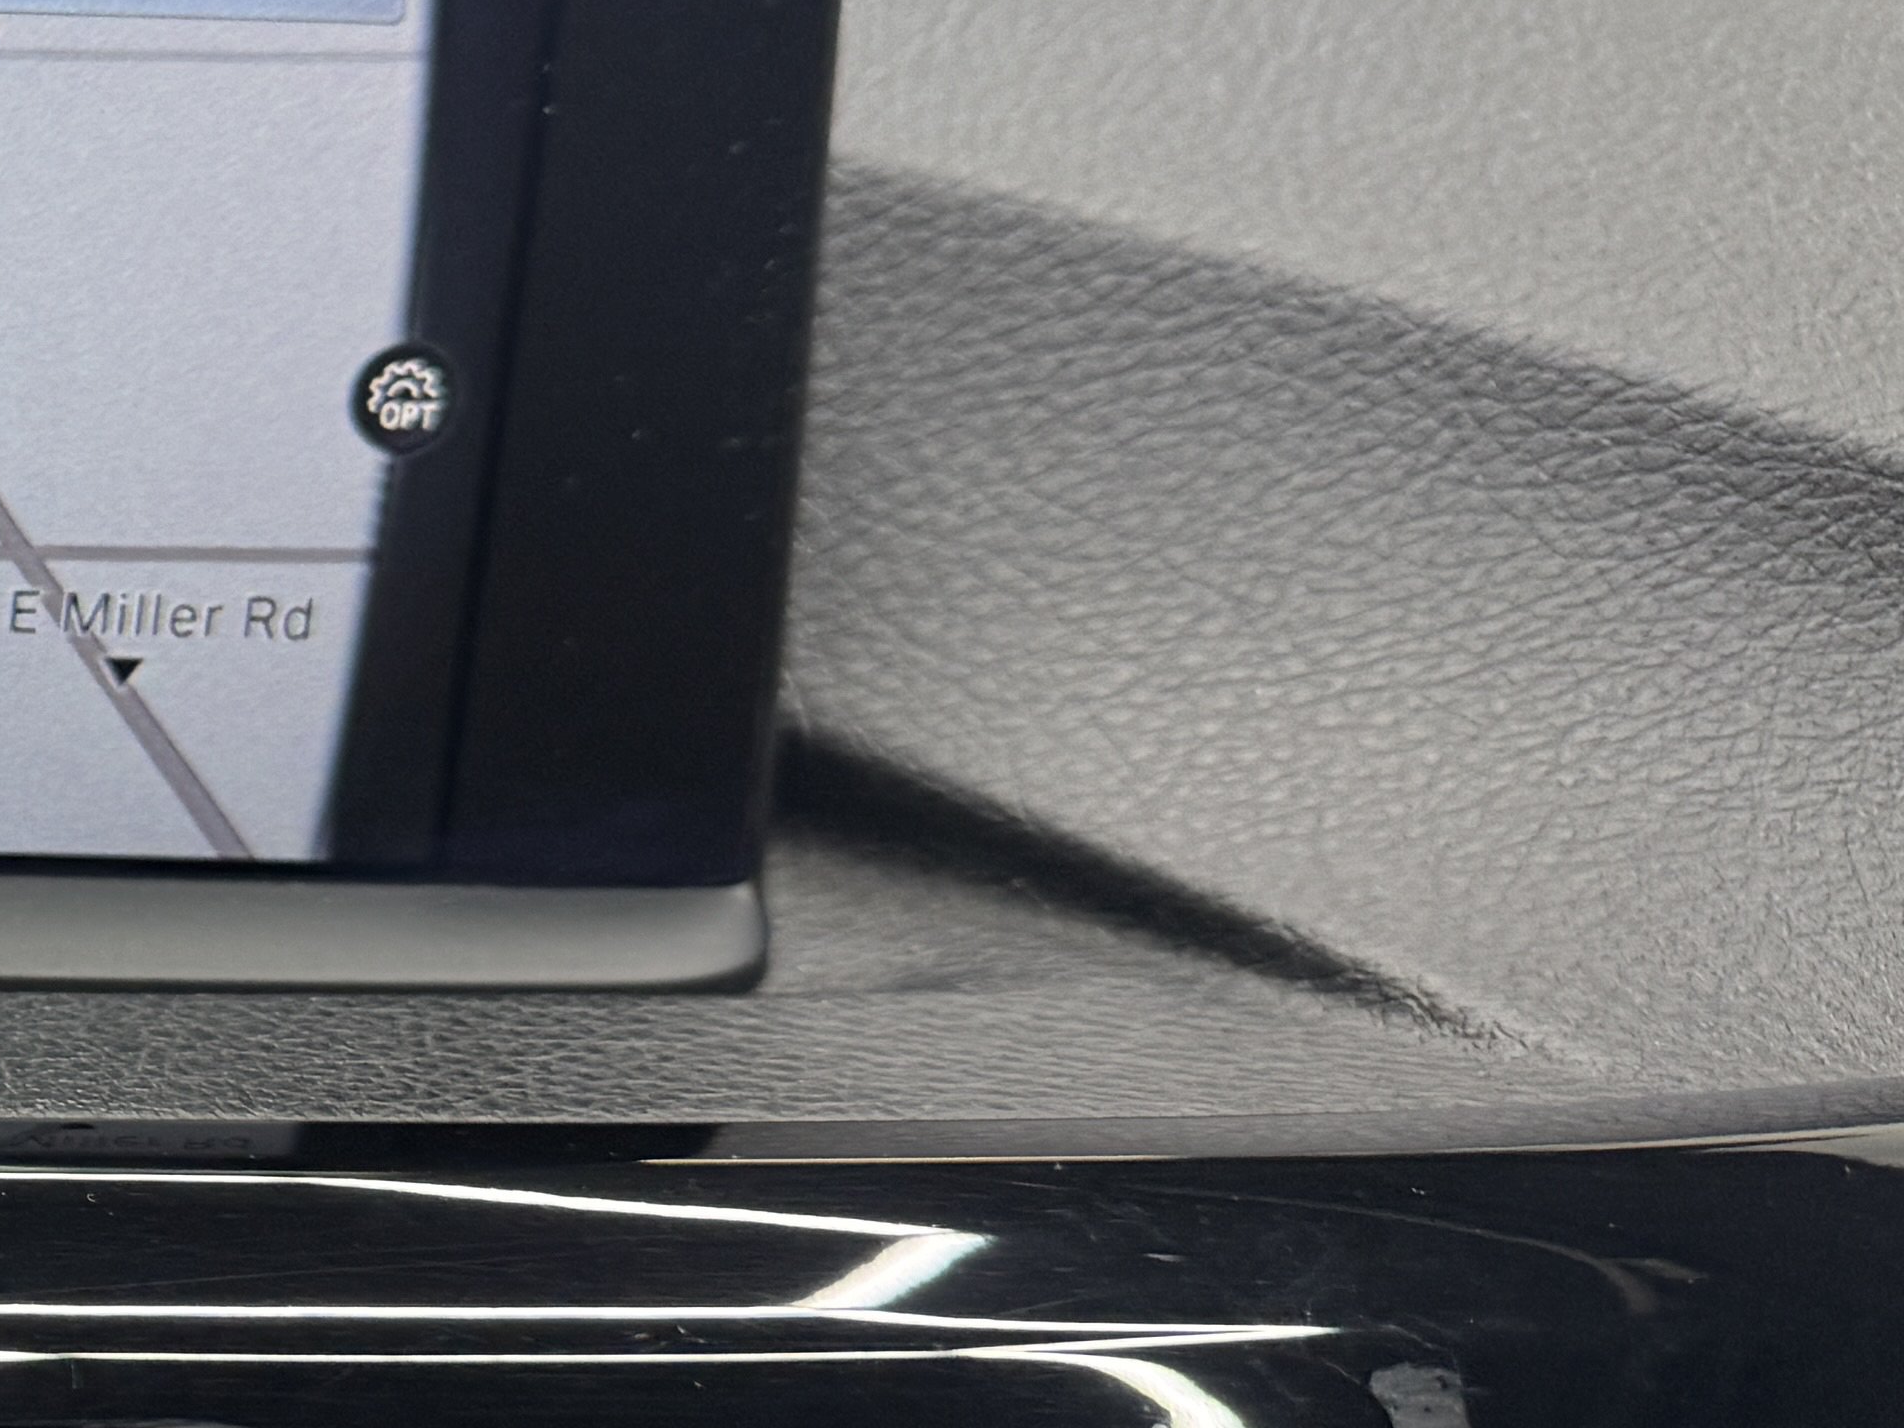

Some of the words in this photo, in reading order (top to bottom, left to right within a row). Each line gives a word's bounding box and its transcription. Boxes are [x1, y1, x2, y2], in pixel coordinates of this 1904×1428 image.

[378, 400, 440, 431] OPT
[8, 589, 41, 634] E
[62, 591, 224, 638] Miller
[243, 595, 314, 642] Rd
